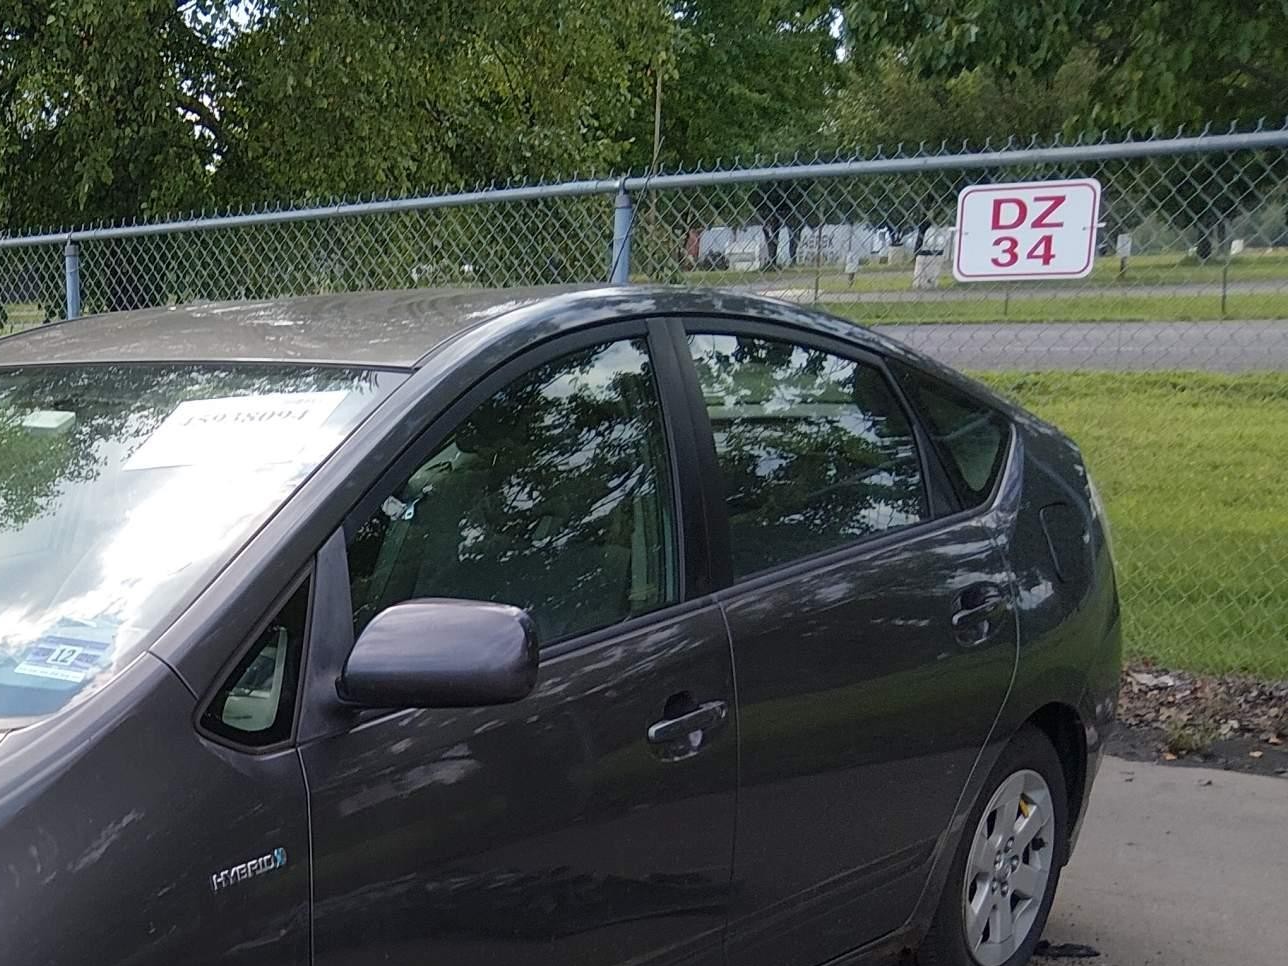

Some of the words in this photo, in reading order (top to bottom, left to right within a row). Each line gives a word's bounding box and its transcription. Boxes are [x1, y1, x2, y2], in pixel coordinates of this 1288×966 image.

[991, 195, 1066, 230] DZ
[991, 234, 1056, 267] 34
[50, 648, 77, 664] 12
[211, 854, 275, 892] HYBRID
